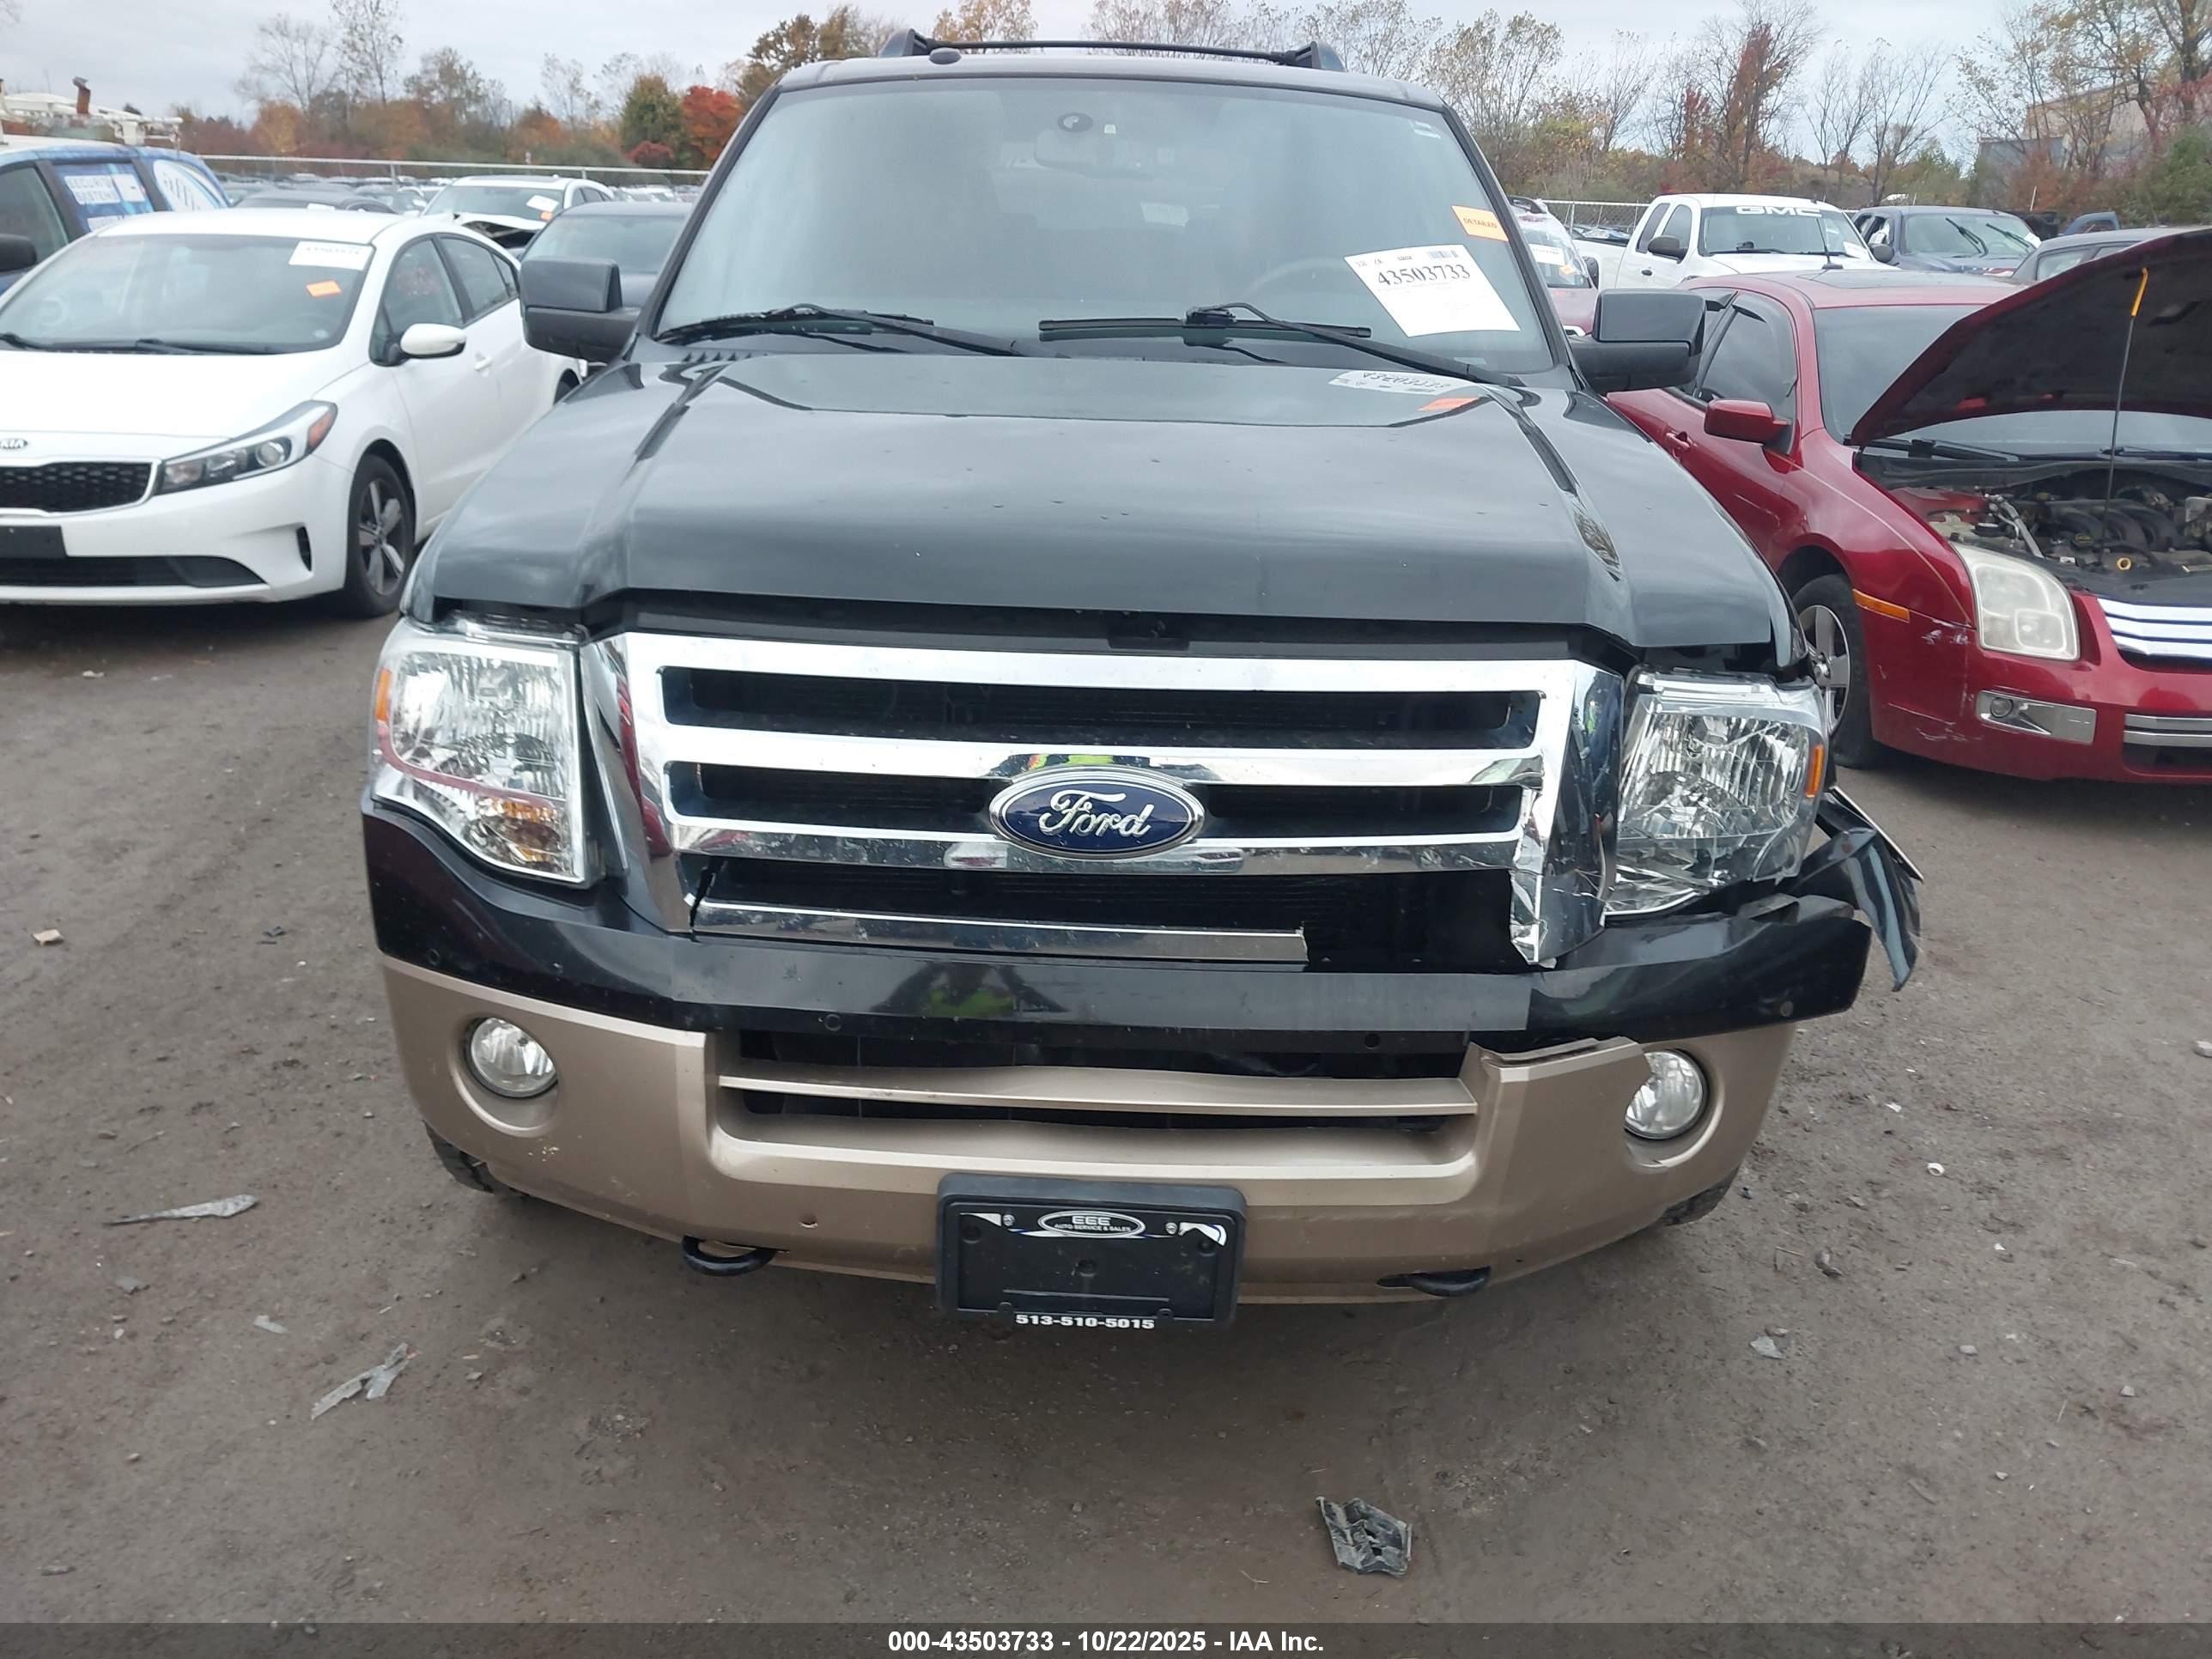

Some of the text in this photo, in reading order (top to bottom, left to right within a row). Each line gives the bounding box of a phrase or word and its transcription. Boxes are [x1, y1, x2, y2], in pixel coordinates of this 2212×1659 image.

[1735, 205, 1822, 218] GMC
[1462, 217, 1498, 229] DETAILED
[1377, 264, 1471, 286] 43503733
[1038, 789, 1155, 837] Ford
[1016, 1314, 1155, 1329] 513-510-5015
